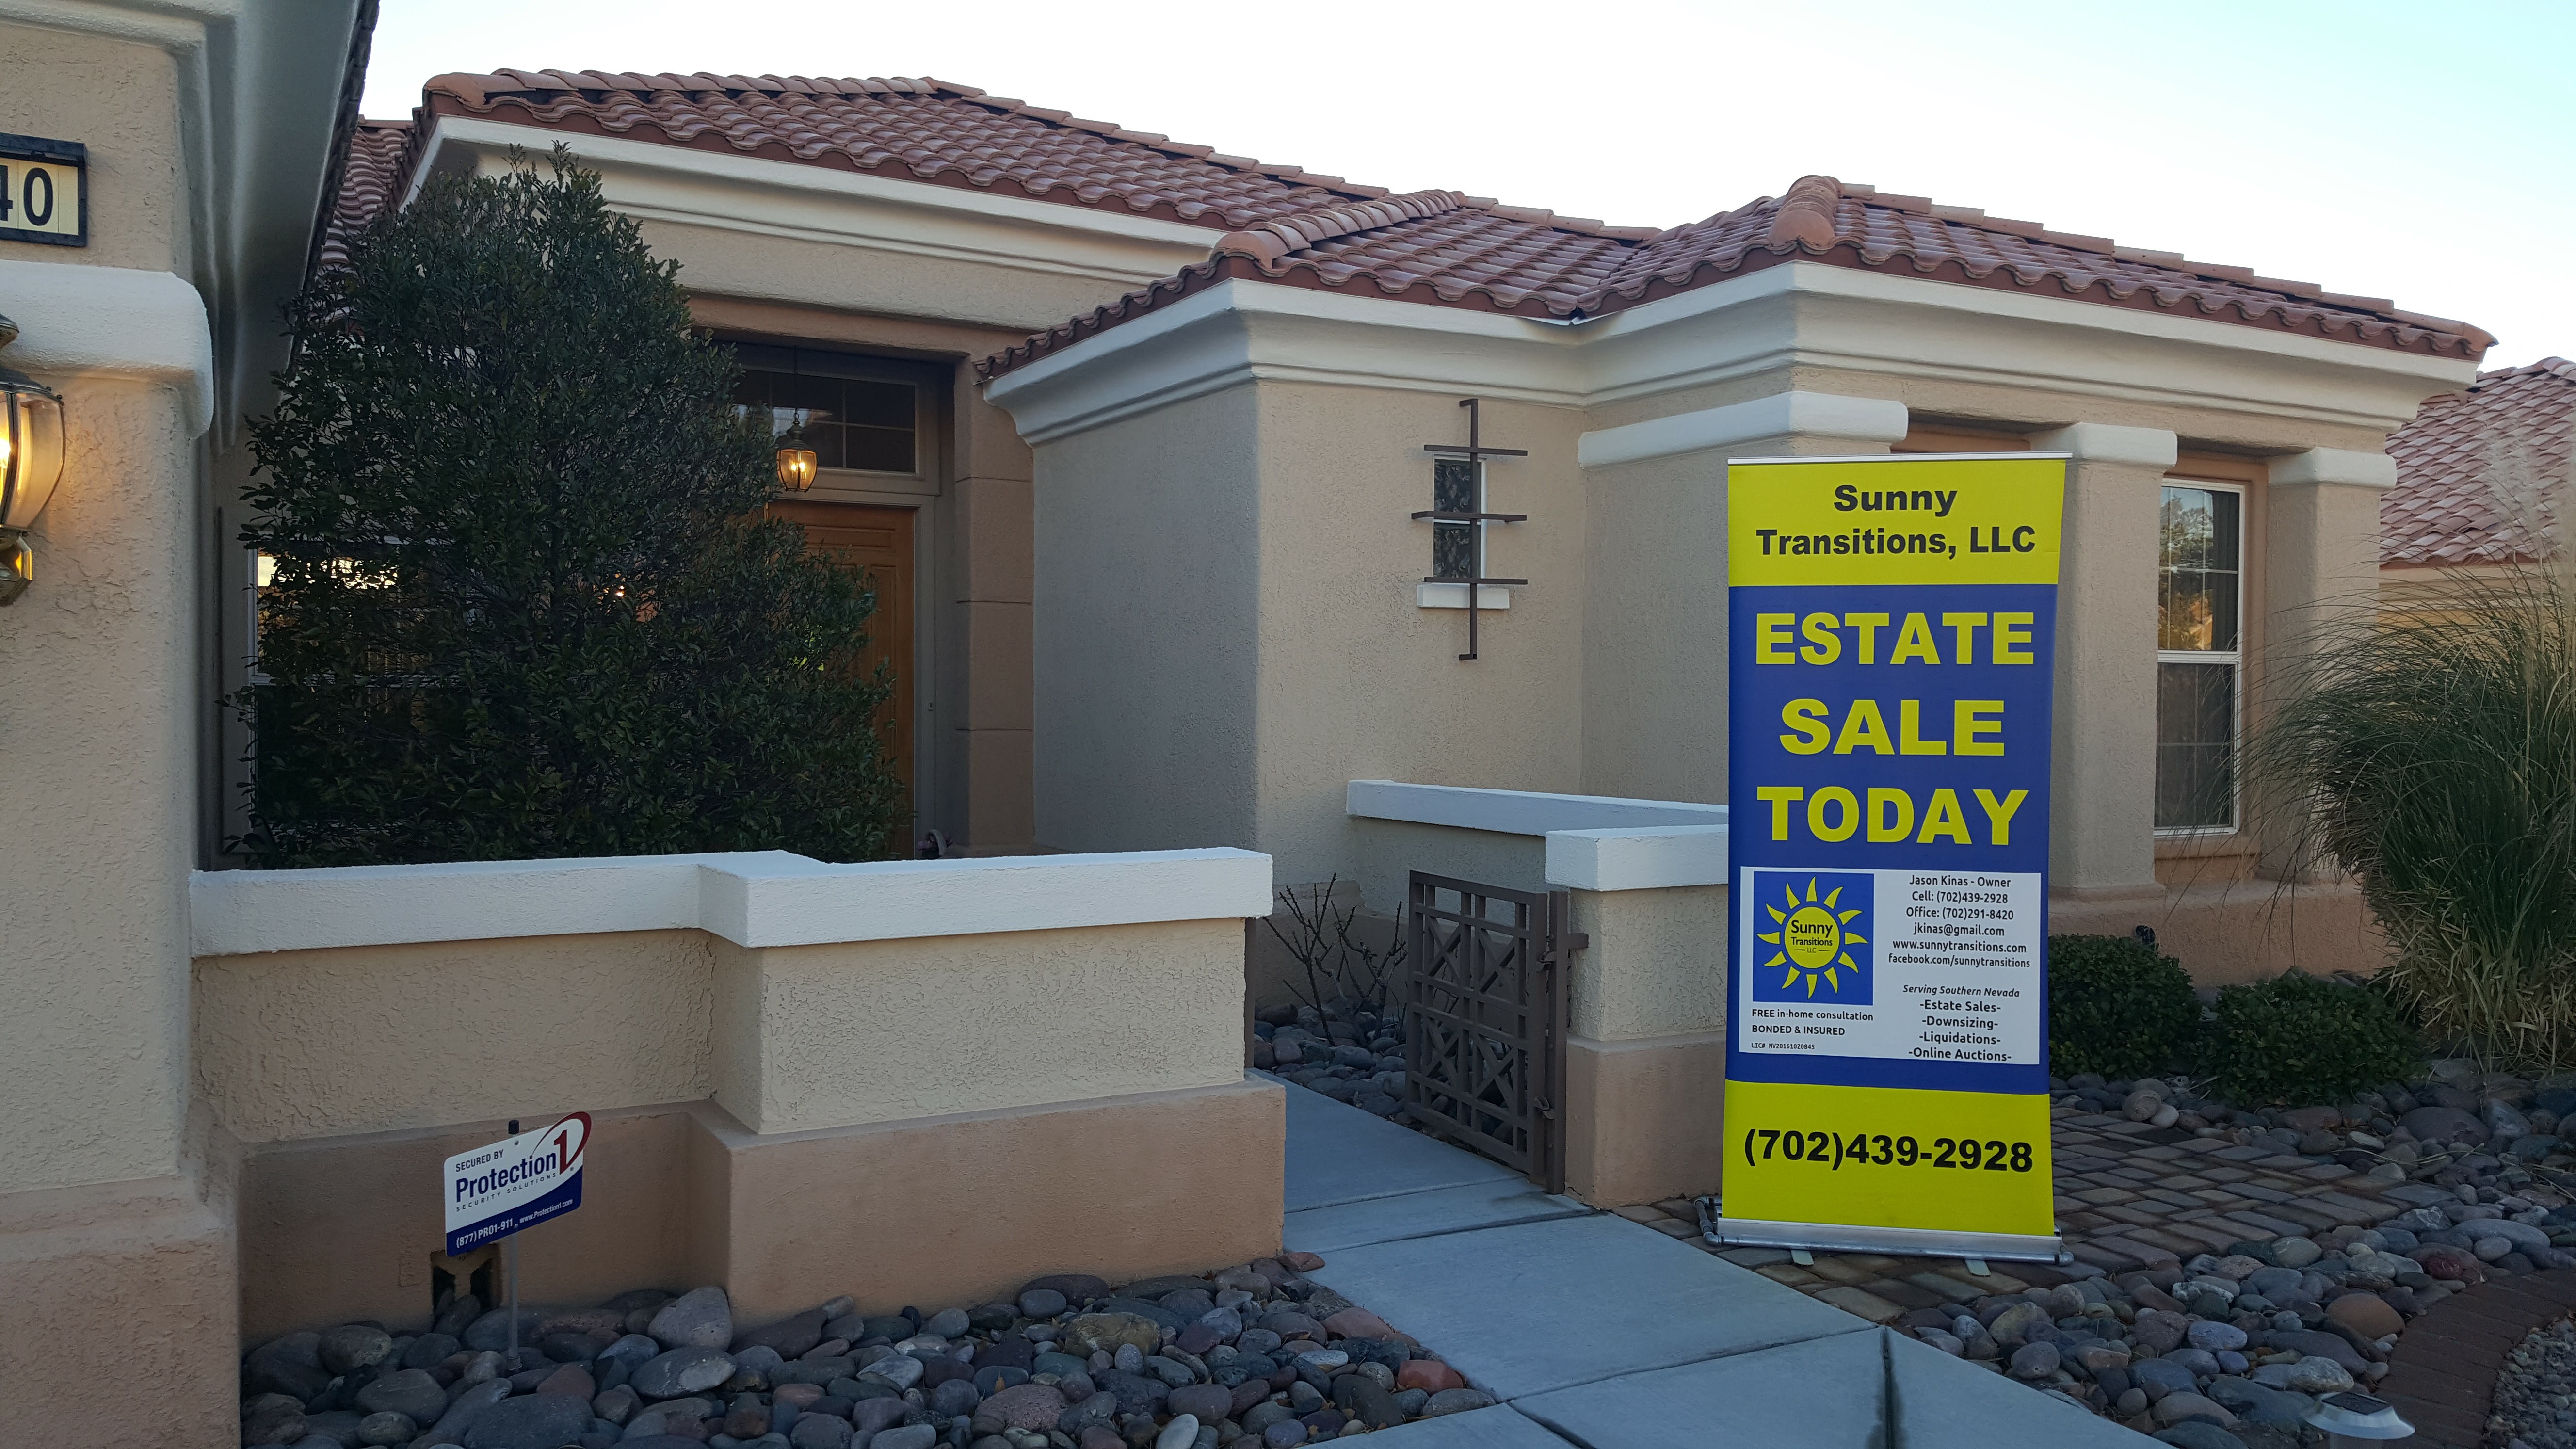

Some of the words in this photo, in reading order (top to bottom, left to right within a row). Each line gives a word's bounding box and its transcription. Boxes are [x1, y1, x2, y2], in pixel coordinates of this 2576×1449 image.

[1833, 484, 1958, 517] Sunny
[1755, 528, 1957, 560] Transitions,
[1969, 526, 2036, 553] LLC
[1755, 612, 2035, 665] ESTATE
[1779, 698, 2005, 757] SALE
[1756, 786, 2029, 846] TODAY
[1909, 875, 1938, 886] Jason
[1941, 875, 1968, 886] Kinas
[1977, 877, 2012, 888] Owner
[1912, 891, 1934, 902] Cell:
[1936, 890, 2009, 904] (702)439-2928
[1906, 906, 1940, 918] Office:
[1942, 906, 2014, 921] (702)291-8420
[1791, 919, 1833, 938] Sunny
[1913, 922, 2005, 936] jkinas@gmail.com
[1790, 936, 1833, 946] Transitions
[1892, 940, 2027, 953] www.sunnytransitions.com
[1888, 952, 2031, 968] facebook.com/sunnytransitions
[1902, 984, 1938, 996] Serving
[1939, 985, 1982, 996] Southern
[1983, 987, 2020, 998] Nevada
[1919, 999, 1963, 1011] -Estate
[1965, 1000, 2002, 1013] Sales-
[1752, 1009, 1775, 1018] FREE
[1777, 1009, 1814, 1019] in-home
[1816, 1011, 1874, 1022] consultation
[1921, 1015, 1999, 1031] -Downsizing-
[1752, 1025, 1792, 1034] BONDED
[1794, 1026, 1801, 1034] &
[1803, 1026, 1846, 1036] INSURED
[1918, 1031, 2001, 1045] -Liquidations-
[1908, 1046, 1952, 1059] -Online
[1954, 1049, 2012, 1062] Auctions-
[1745, 1128, 2033, 1173] (702)439-2928
[455, 1153, 491, 1172] SECURED
[493, 1149, 504, 1160] BY
[456, 1191, 501, 1212] SECURITY
[506, 1172, 556, 1194] SOLUTIONS
[519, 1199, 573, 1224] www.Protection1.com
[456, 1231, 477, 1249] (877)
